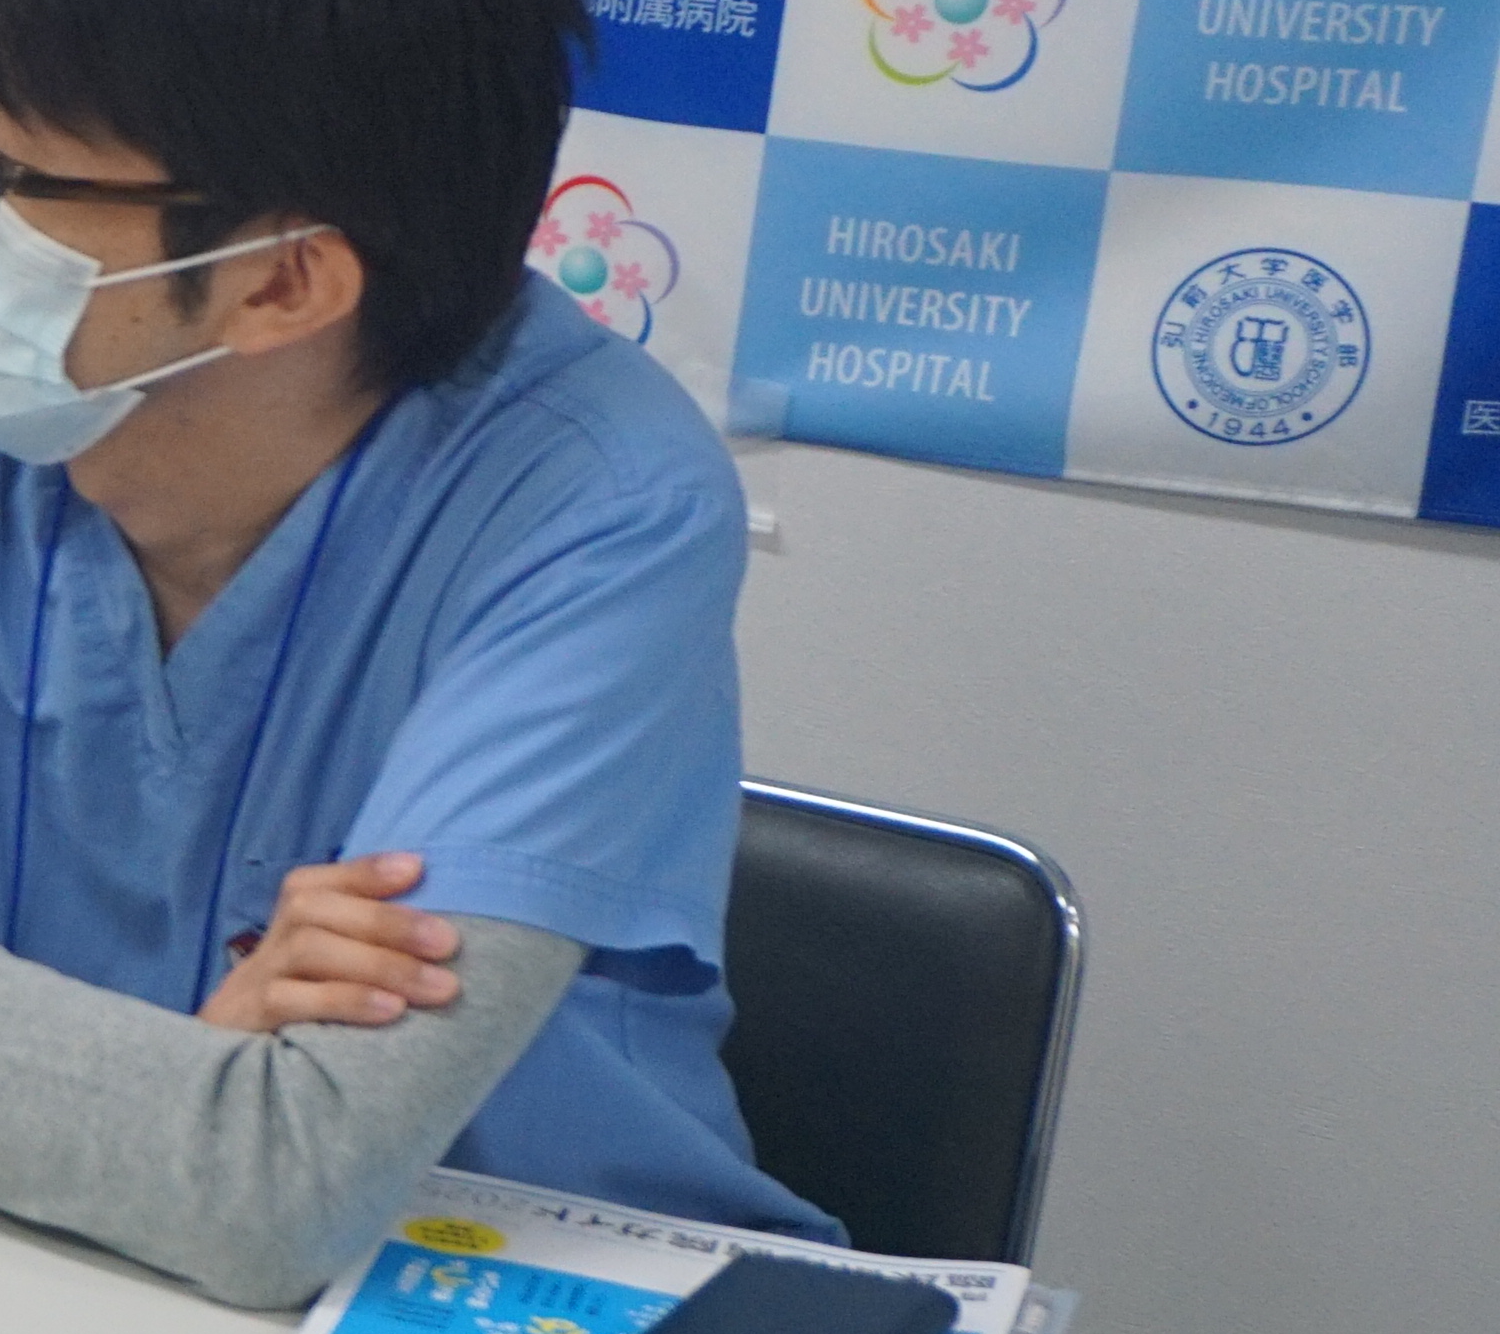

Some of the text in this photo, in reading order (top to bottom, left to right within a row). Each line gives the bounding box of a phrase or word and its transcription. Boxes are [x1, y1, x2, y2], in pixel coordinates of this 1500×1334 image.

[1204, 61, 1408, 114] HOSPITAL
[826, 215, 1021, 272] HIROSAKI
[800, 277, 1032, 338] UNIVERSITY
[806, 341, 995, 403] HOSPITAL
[1207, 412, 1290, 437] 1944
